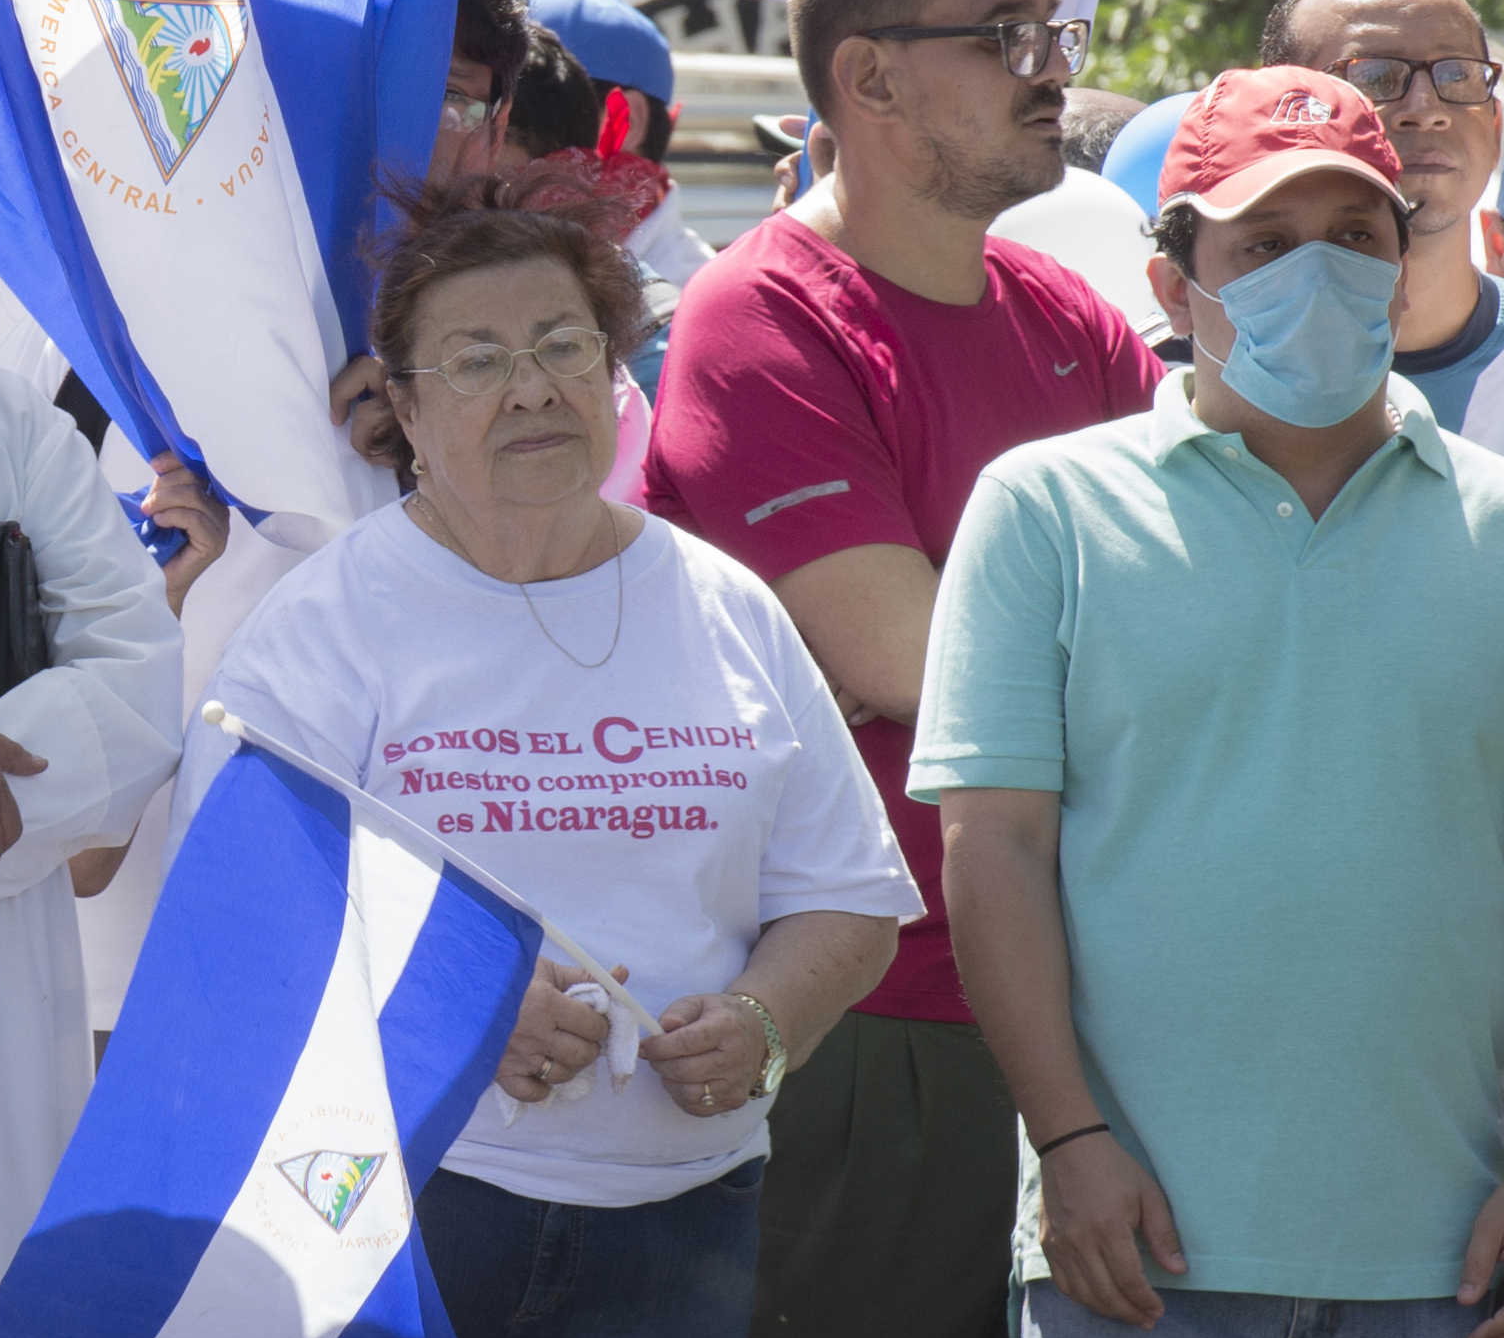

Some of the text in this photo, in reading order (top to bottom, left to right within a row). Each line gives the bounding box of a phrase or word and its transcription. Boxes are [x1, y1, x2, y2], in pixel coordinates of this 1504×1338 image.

[62, 130, 178, 215] CENTRAL
[383, 716, 757, 765] SOMOS EL CENIDH
[399, 764, 748, 797] Nuestro compromiso
[437, 800, 720, 839] es Nicaragua.
